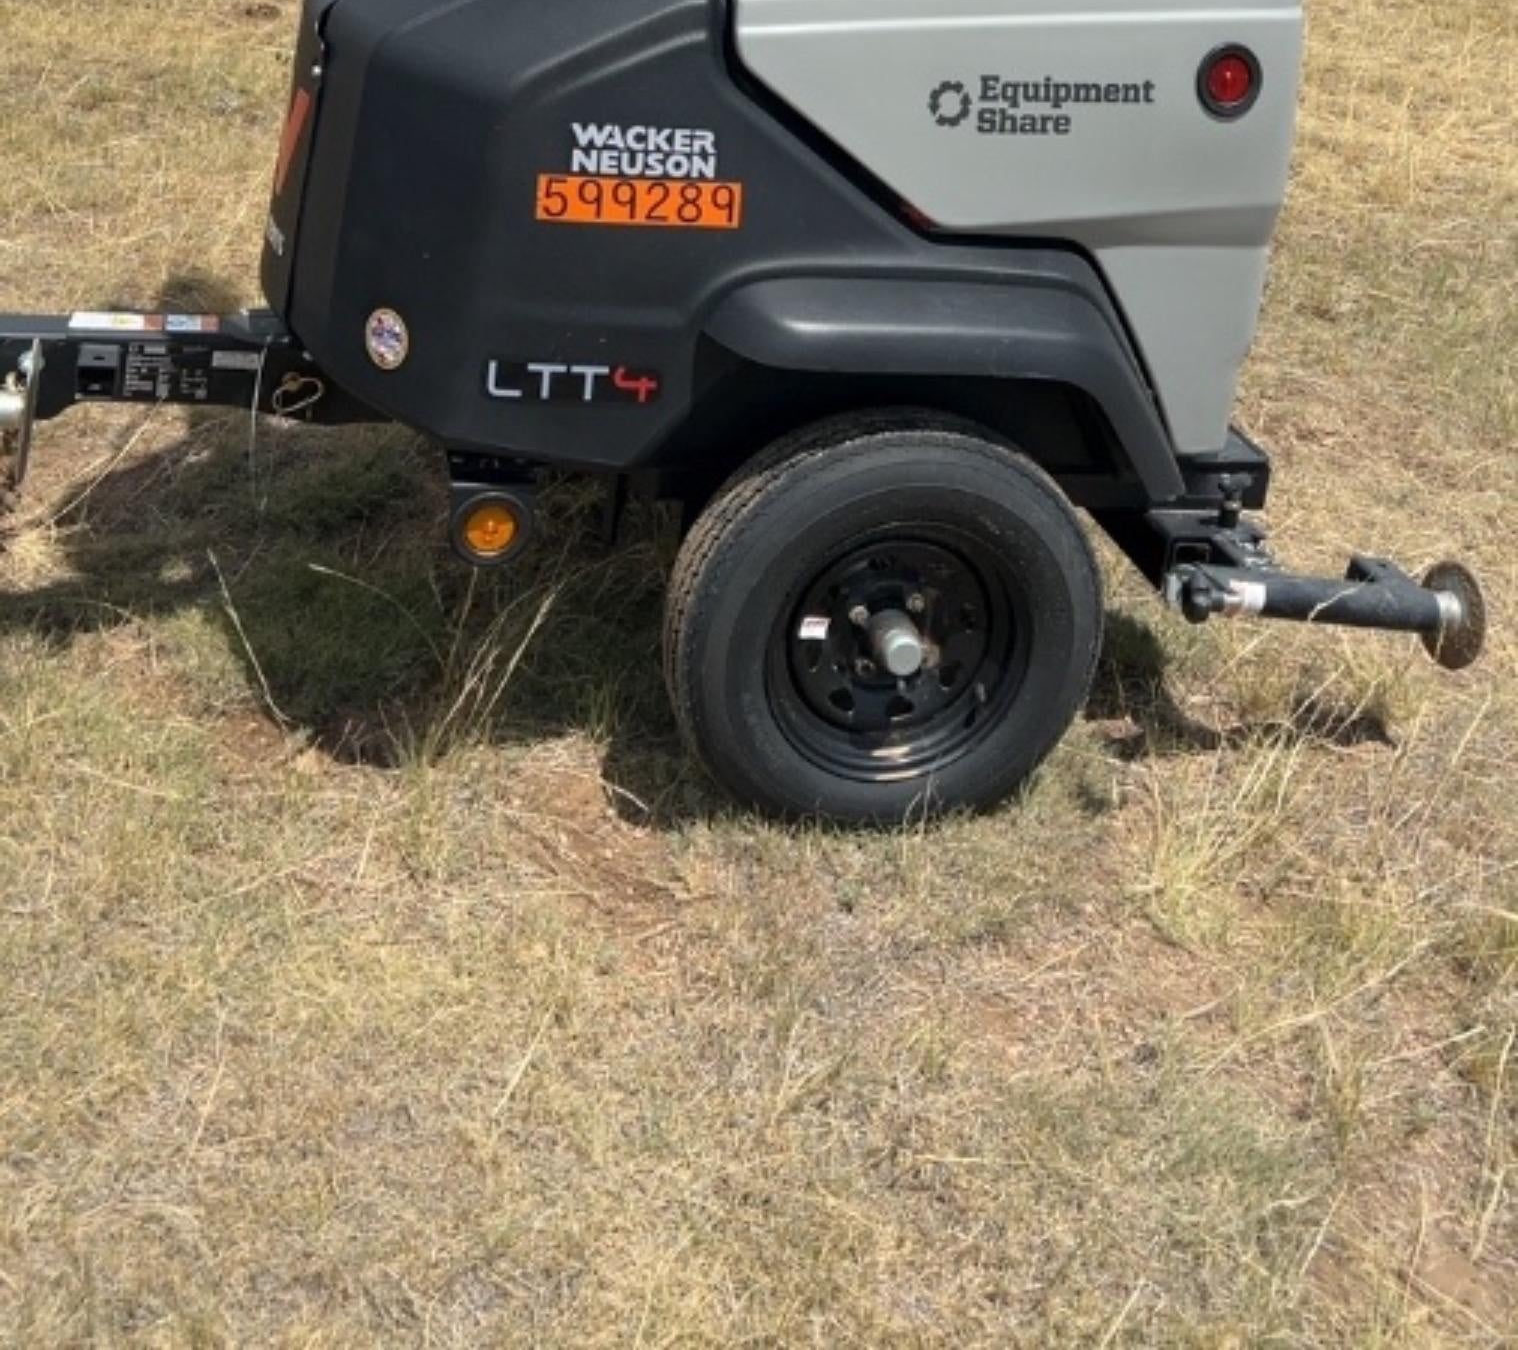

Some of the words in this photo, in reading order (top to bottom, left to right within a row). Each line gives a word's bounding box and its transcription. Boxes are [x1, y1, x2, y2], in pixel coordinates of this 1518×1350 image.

[979, 75, 1154, 108] Equipment
[977, 108, 1071, 134] Share
[572, 123, 715, 153] WACKER
[572, 150, 716, 178] NEUSON
[543, 178, 736, 223] 599289
[488, 360, 657, 402] LTT4
